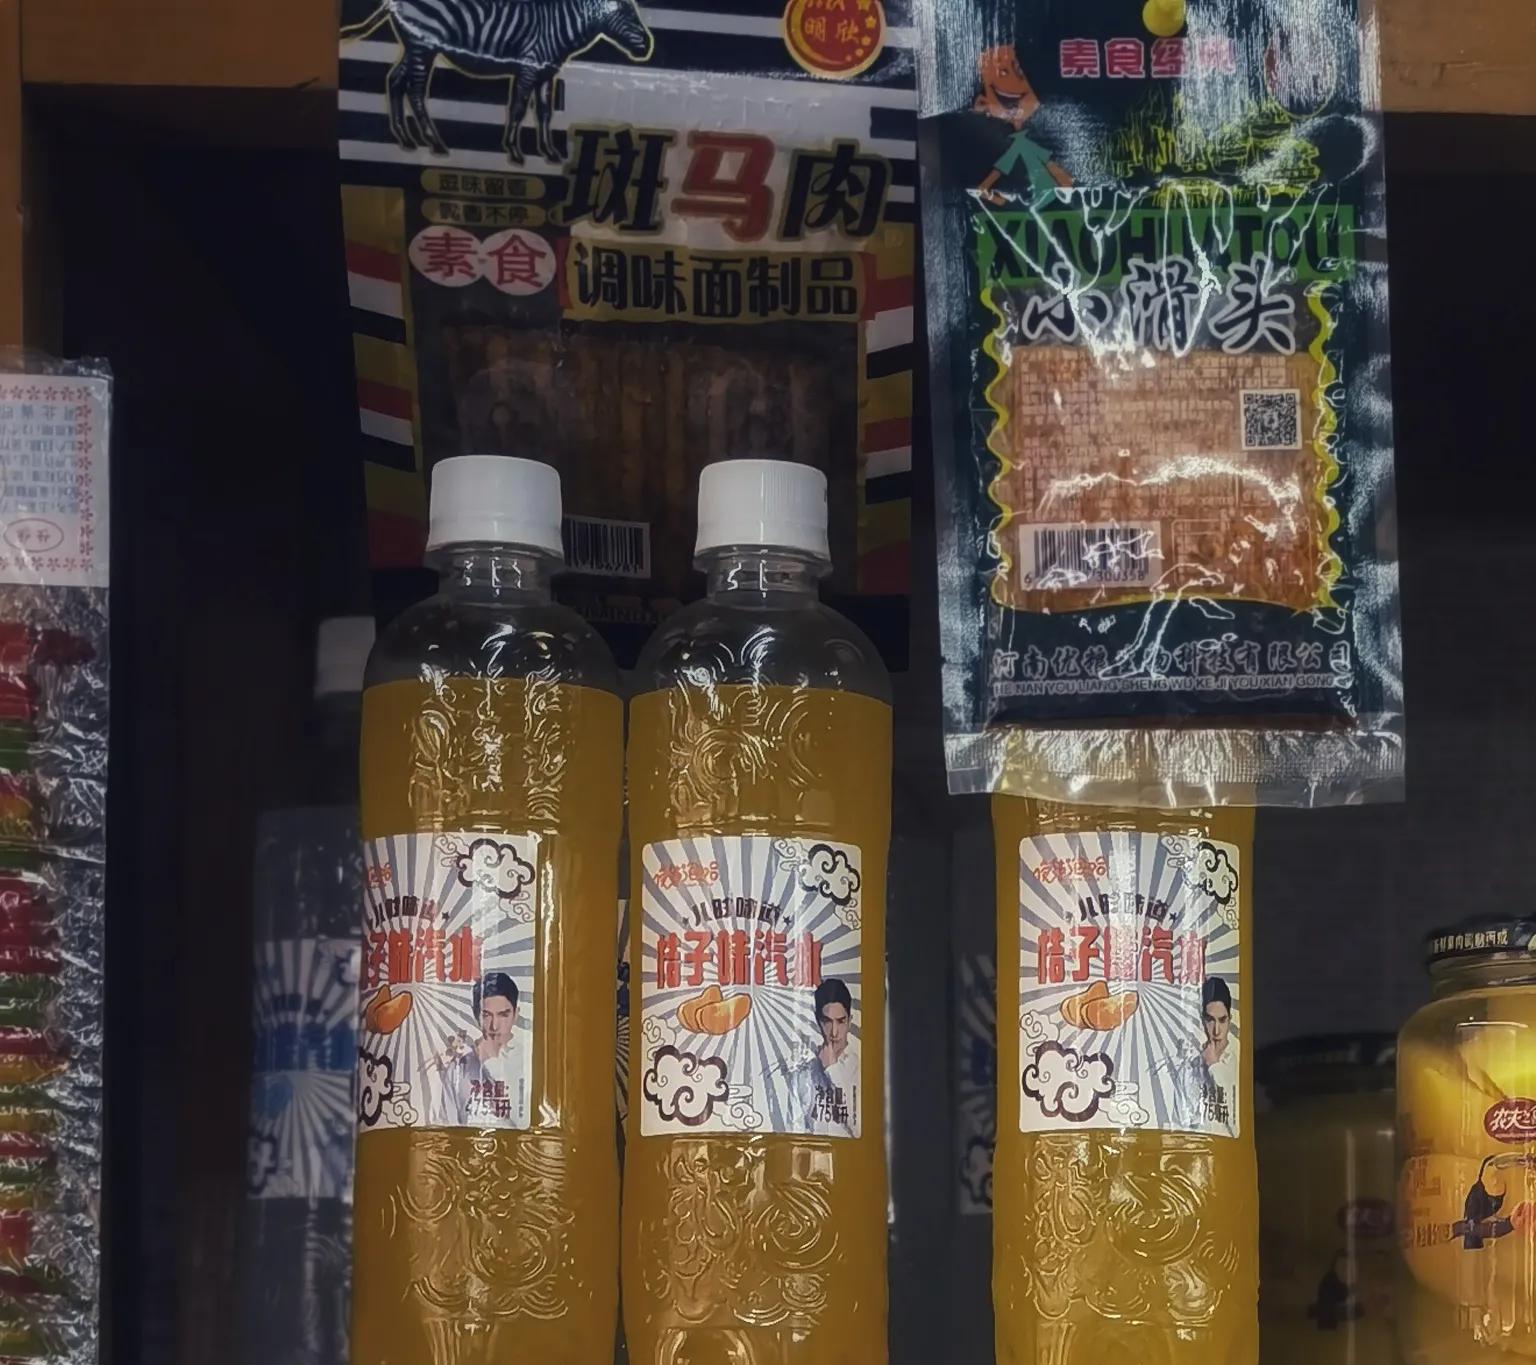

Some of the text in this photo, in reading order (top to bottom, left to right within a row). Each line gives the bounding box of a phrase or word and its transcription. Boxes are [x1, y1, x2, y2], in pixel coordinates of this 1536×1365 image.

[562, 129, 890, 240] 斑马肉
[418, 232, 546, 288] 素食
[575, 242, 859, 317] 调味面制品
